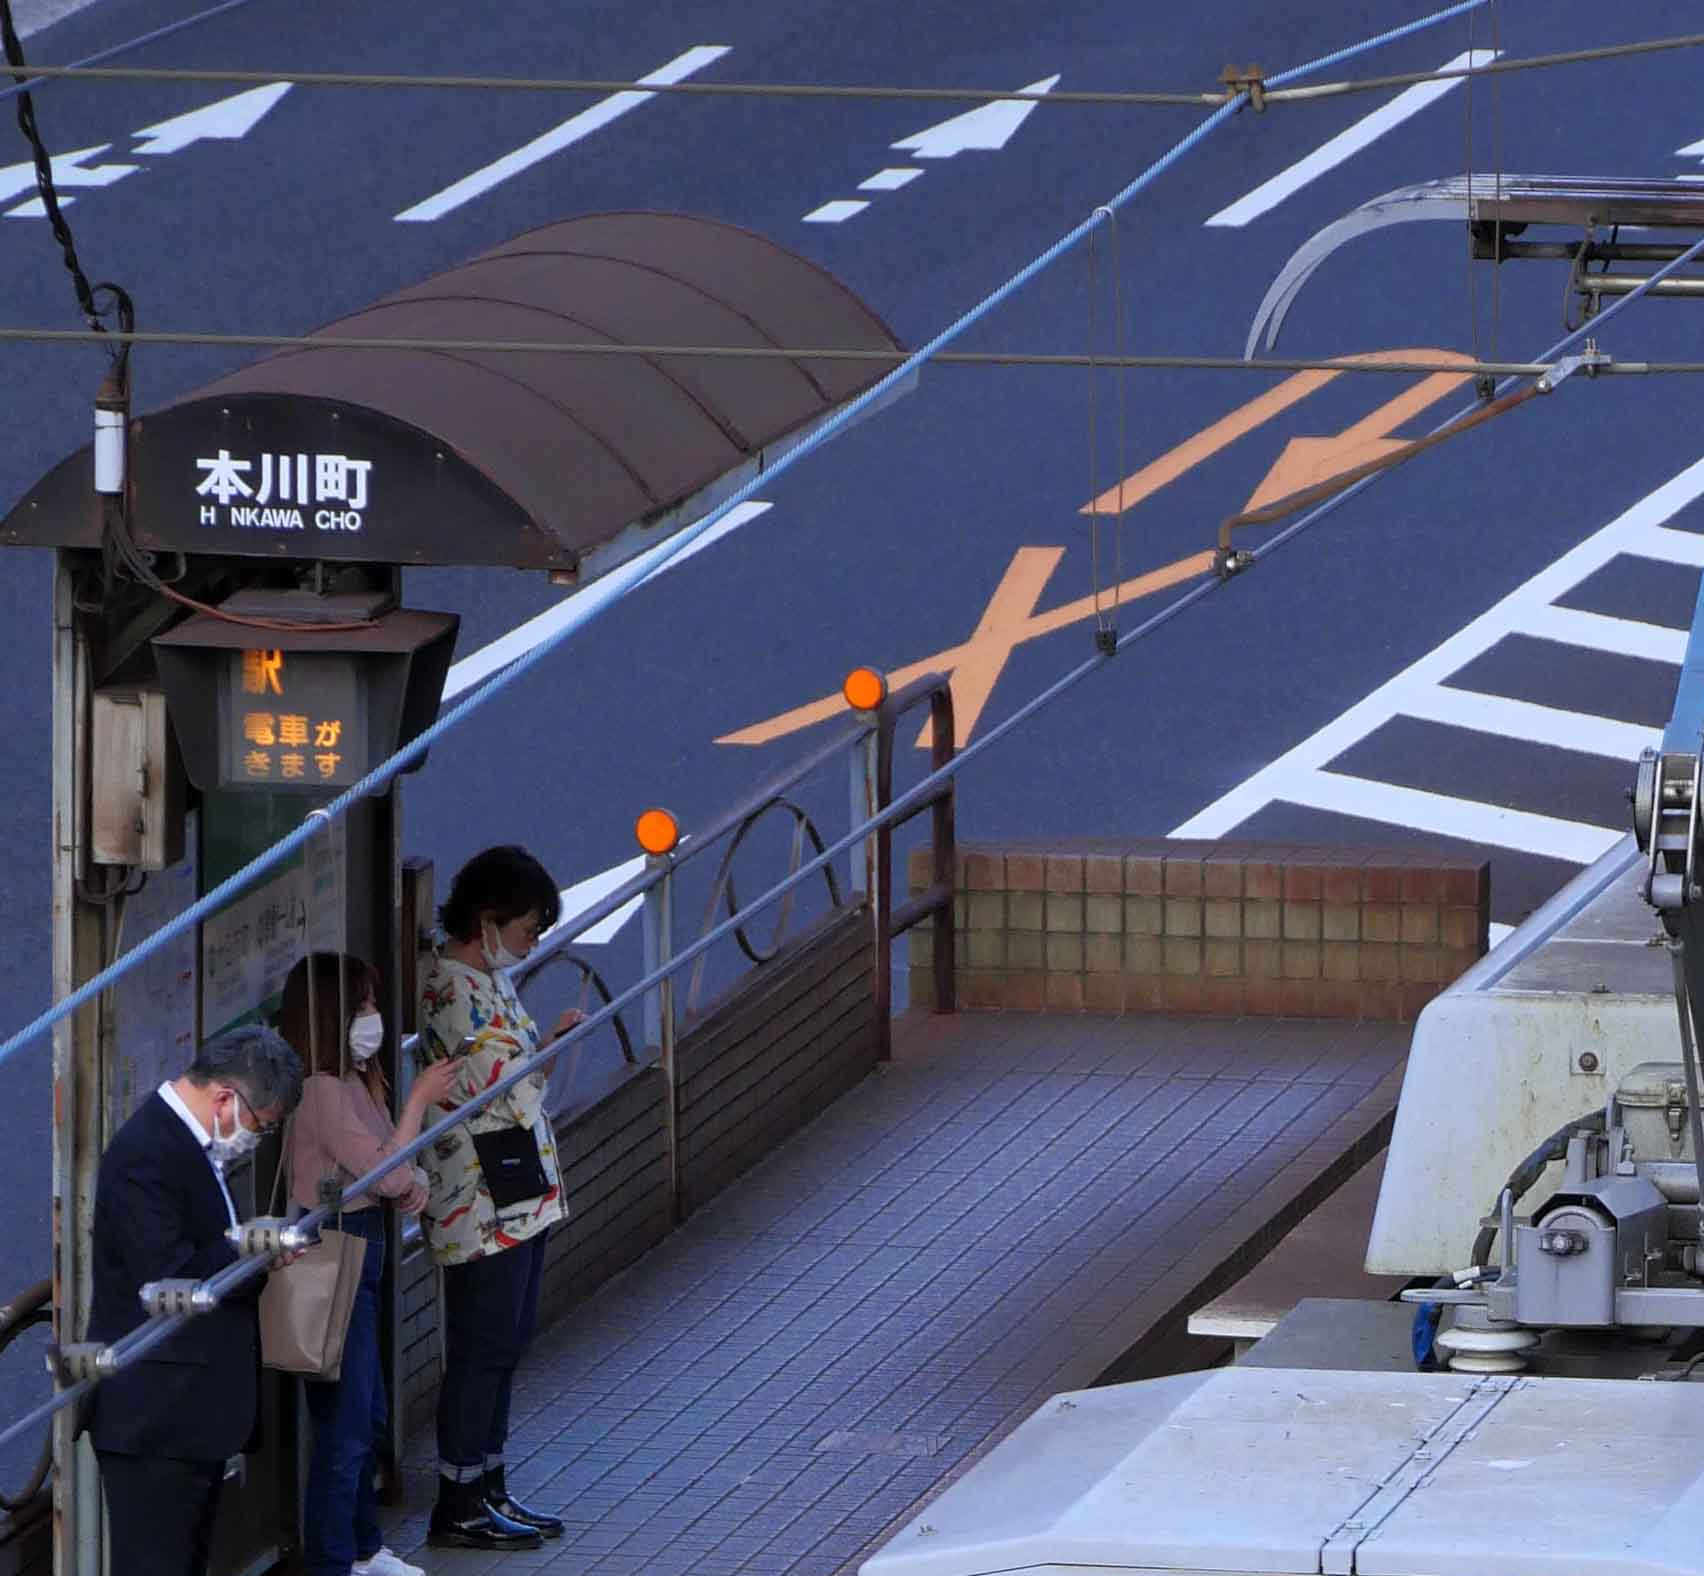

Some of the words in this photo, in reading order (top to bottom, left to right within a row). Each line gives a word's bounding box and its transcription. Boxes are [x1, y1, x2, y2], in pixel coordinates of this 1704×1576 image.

[196, 449, 372, 509] 本川町
[314, 510, 362, 530] CHO
[244, 712, 342, 748] 電車が
[243, 751, 342, 778] きます
